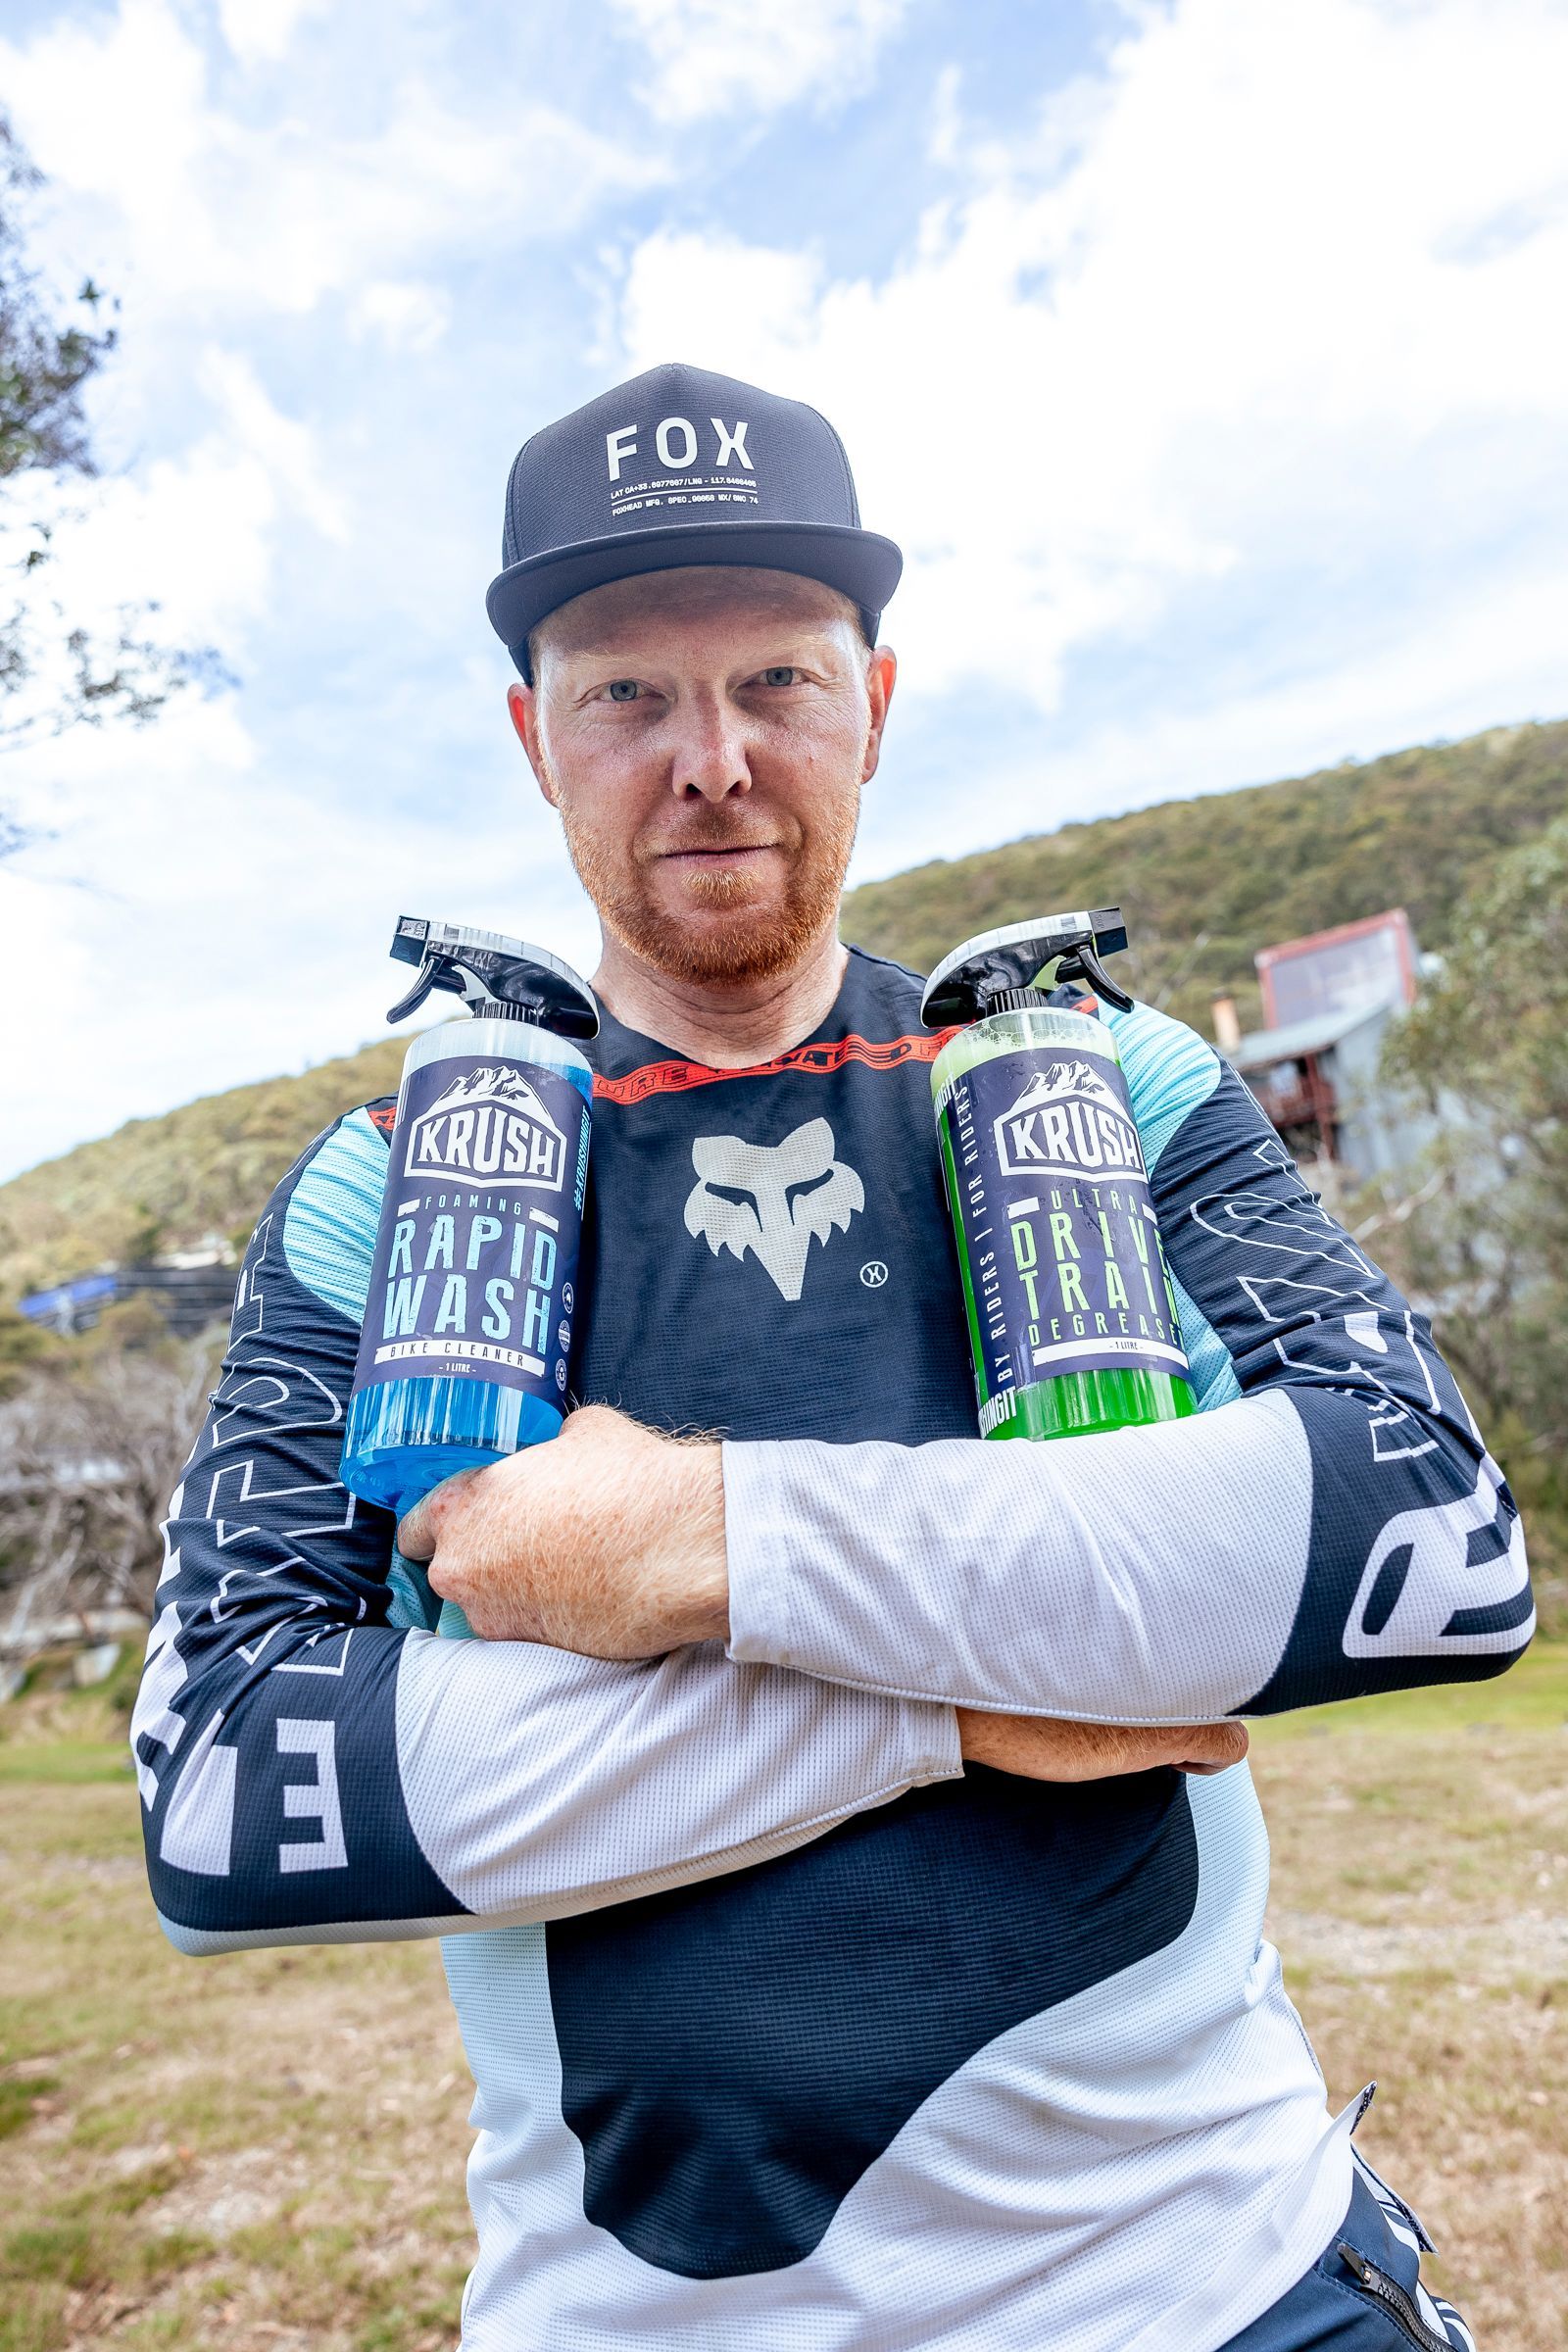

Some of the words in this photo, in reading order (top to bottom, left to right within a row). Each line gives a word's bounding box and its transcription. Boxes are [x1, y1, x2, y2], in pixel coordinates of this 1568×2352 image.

[606, 416, 755, 482] FOX
[611, 488, 624, 500] LAT
[612, 501, 643, 516] FOXHEAD
[416, 1106, 557, 1178] KRUSH
[572, 1104, 590, 1211] #KRUSHINGIT
[955, 1086, 979, 1166] RIDERS
[1008, 1102, 1146, 1172] KRUSH
[424, 1196, 522, 1216] FOAMING
[968, 1173, 988, 1218] FOR
[1051, 1188, 1138, 1216] ULTRA
[388, 1214, 558, 1292] RAPID
[1010, 1212, 1170, 1277] DRIVE
[382, 1273, 552, 1355] WASH
[980, 1251, 1006, 1340] RIDERS
[1019, 1261, 1180, 1329] TRAIN
[389, 1342, 429, 1358] BIKE
[444, 1342, 524, 1367] CLEANER
[451, 1362, 471, 1373] LITRE
[994, 1353, 1013, 1383] BY
[1120, 1341, 1139, 1350] LITRE
